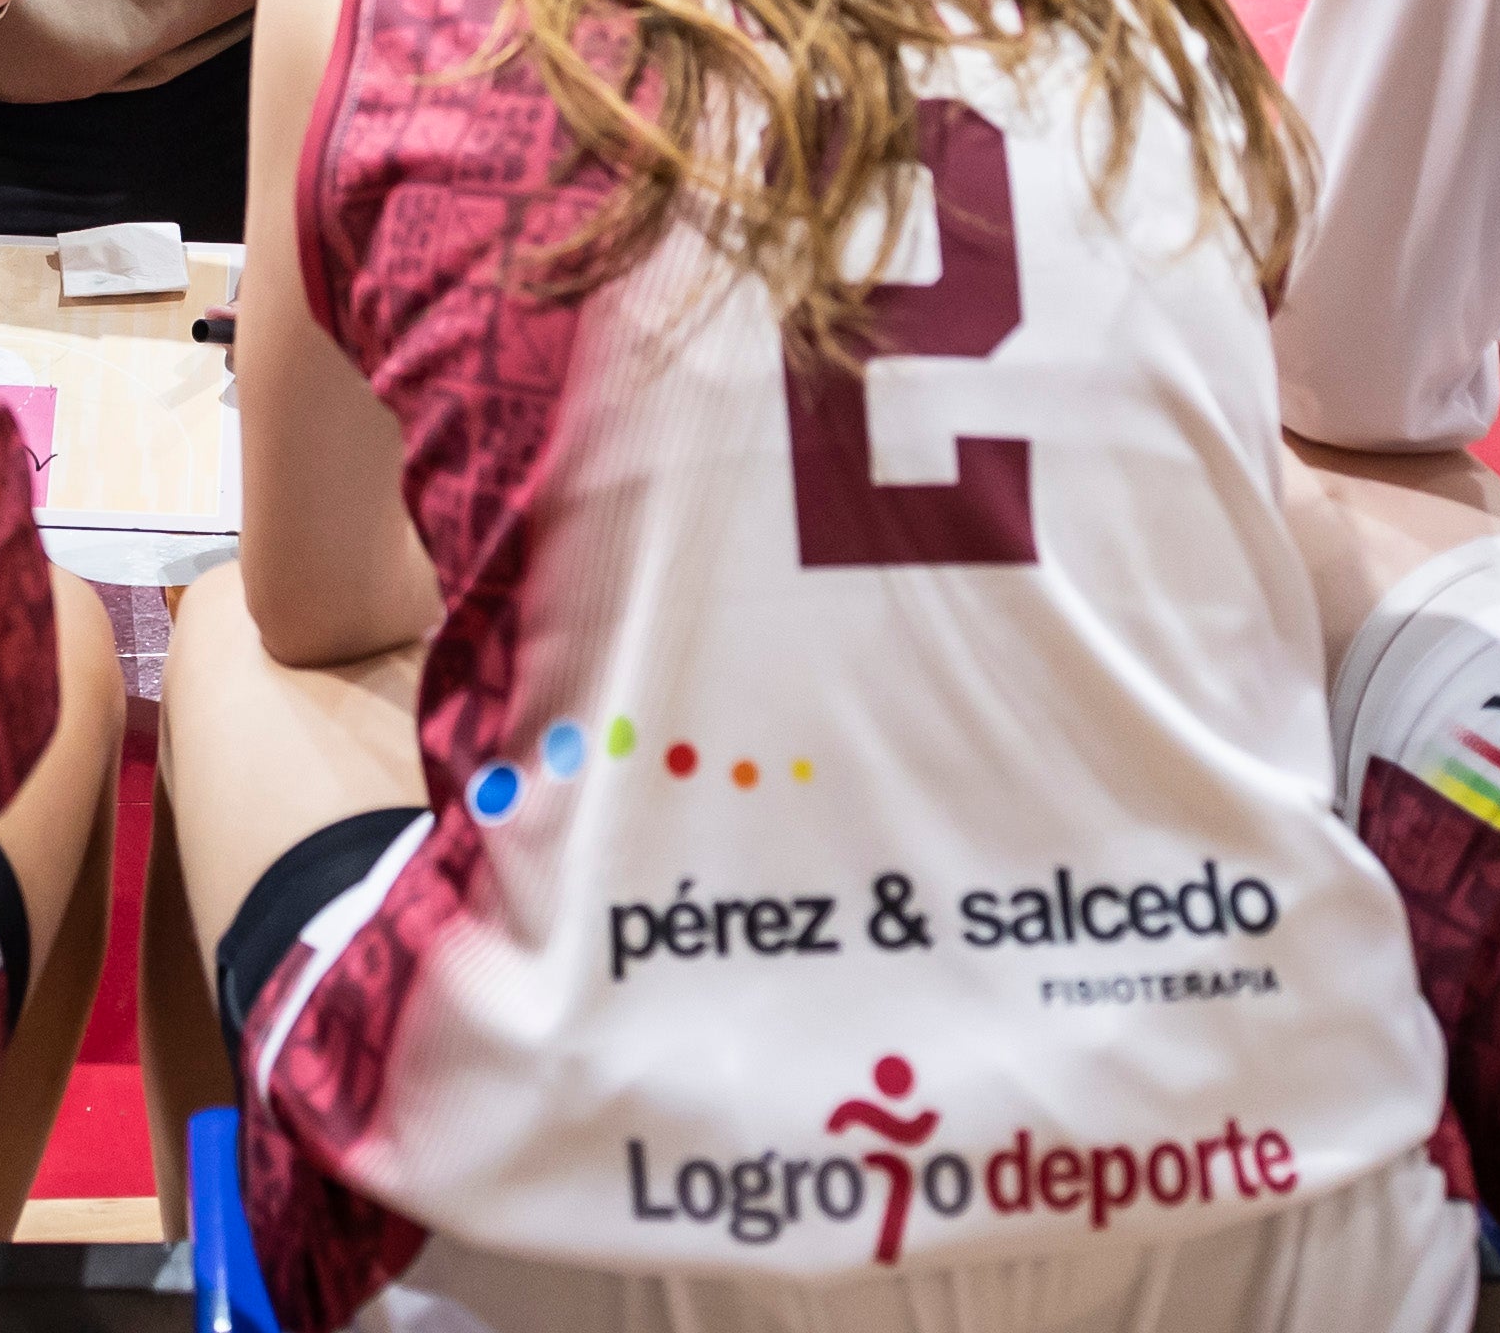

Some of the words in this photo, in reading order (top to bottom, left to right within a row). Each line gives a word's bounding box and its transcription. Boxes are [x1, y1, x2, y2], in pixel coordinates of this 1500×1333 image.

[764, 97, 1040, 567] 2
[608, 876, 844, 981] pérez
[867, 871, 934, 955] &
[958, 859, 1281, 951] salcedo
[1039, 965, 1283, 1009] FISIOTERAPIA
[983, 1117, 1302, 1230] deporte
